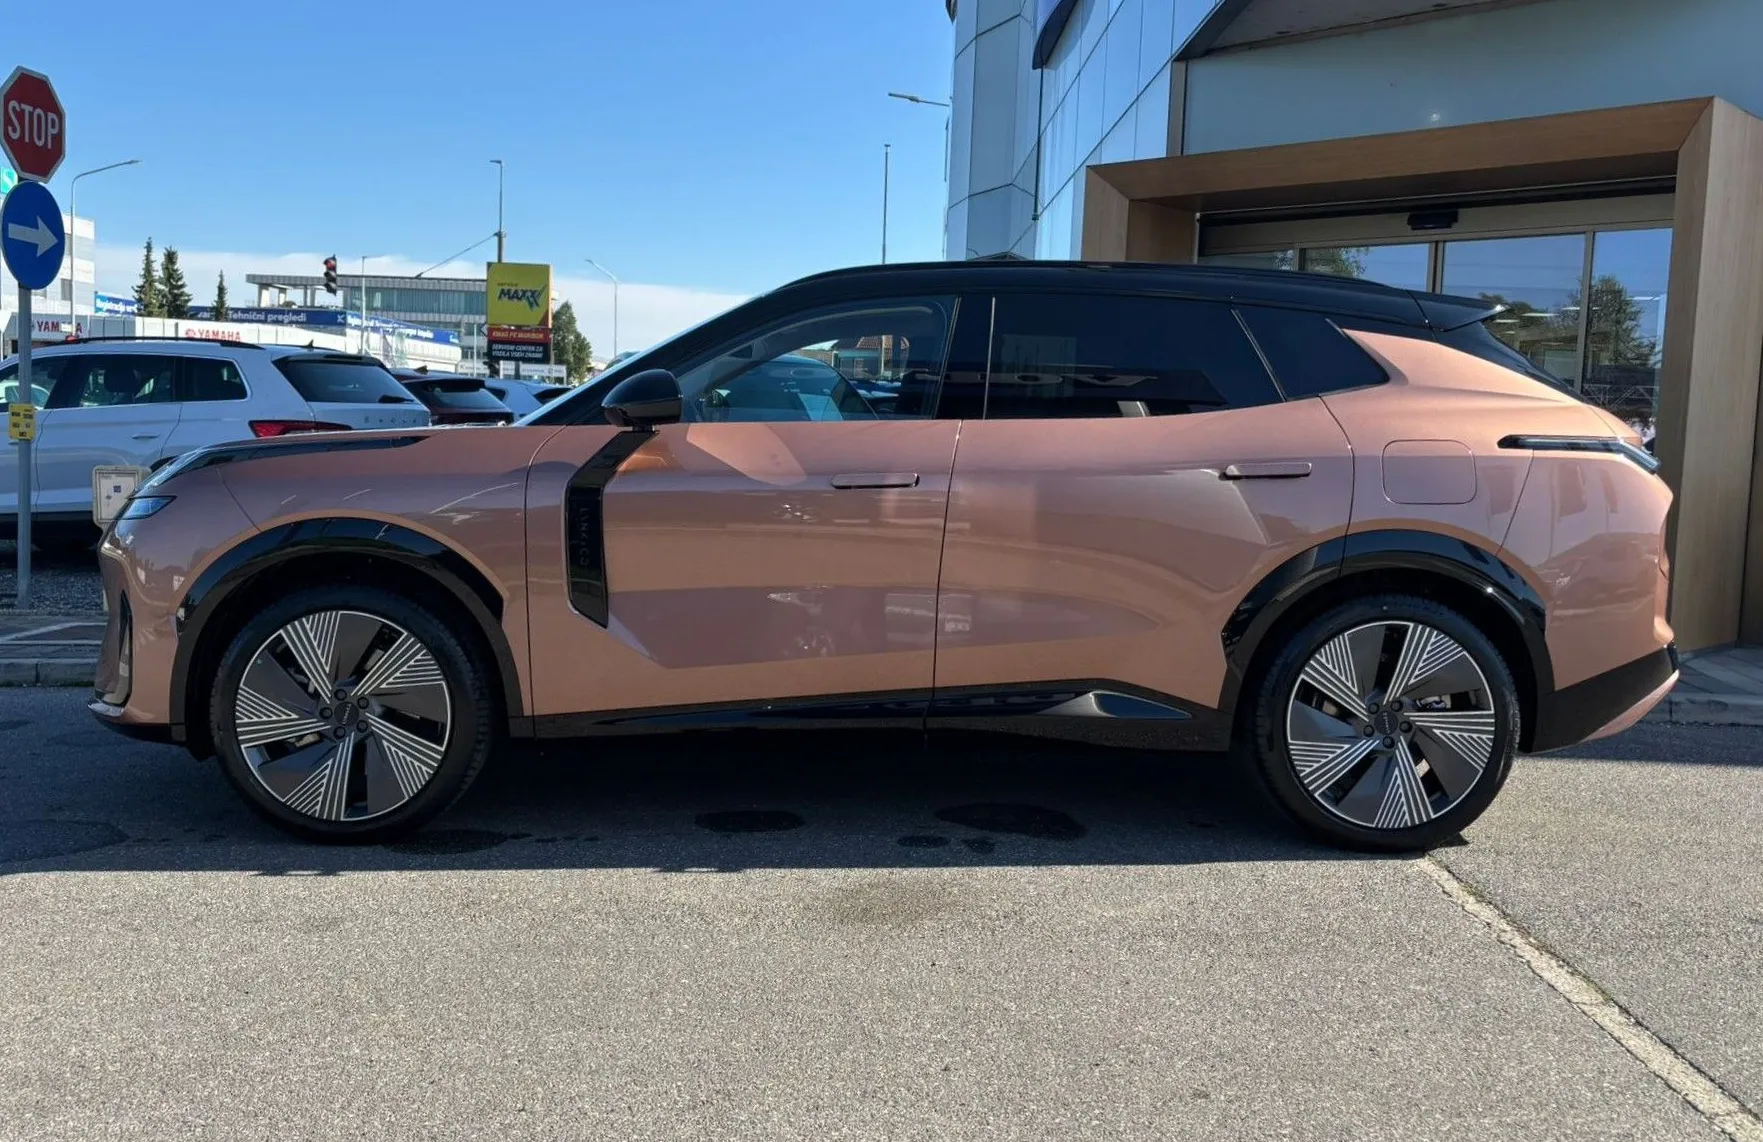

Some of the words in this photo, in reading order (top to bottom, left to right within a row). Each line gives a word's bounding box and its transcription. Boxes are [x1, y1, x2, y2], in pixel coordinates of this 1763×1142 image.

[7, 100, 60, 149] STOP
[498, 288, 541, 312] MAXX
[228, 310, 265, 320] Tehnični
[267, 312, 307, 323] pregledi
[37, 320, 83, 334] YAMA
[198, 328, 241, 340] YAMAHA
